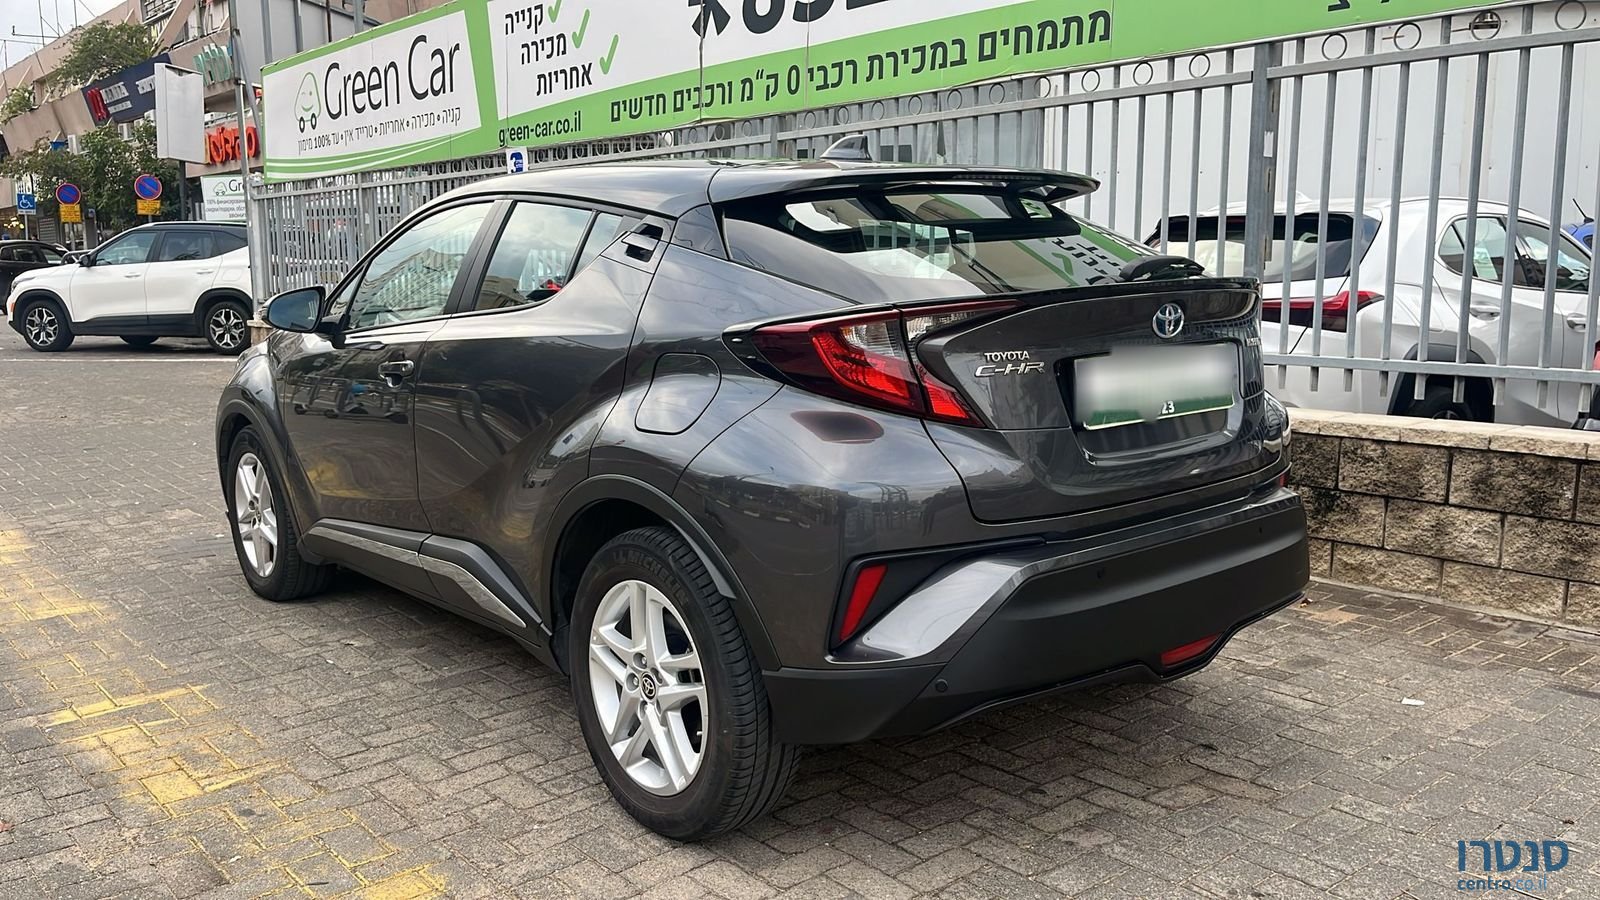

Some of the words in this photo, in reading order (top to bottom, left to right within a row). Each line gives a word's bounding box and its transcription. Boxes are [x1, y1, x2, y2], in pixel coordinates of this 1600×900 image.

[505, 3, 544, 35] קנייה
[521, 33, 567, 65] מכירה
[978, 9, 1111, 62] מתמחים
[807, 59, 858, 91] רכבי
[866, 38, 967, 82] במכירת
[324, 60, 400, 120] Green
[407, 34, 460, 101] Car
[536, 62, 593, 96] אחריות
[787, 64, 801, 96] 0
[610, 92, 667, 122] חדשים
[673, 80, 733, 113] ורכבים
[379, 118, 405, 136] אחריות
[411, 112, 435, 130] מכירה
[442, 106, 461, 127] קניה
[314, 135, 331, 147] 100%
[975, 361, 1045, 377] C-HR
[984, 350, 1031, 362] TOYOTA
